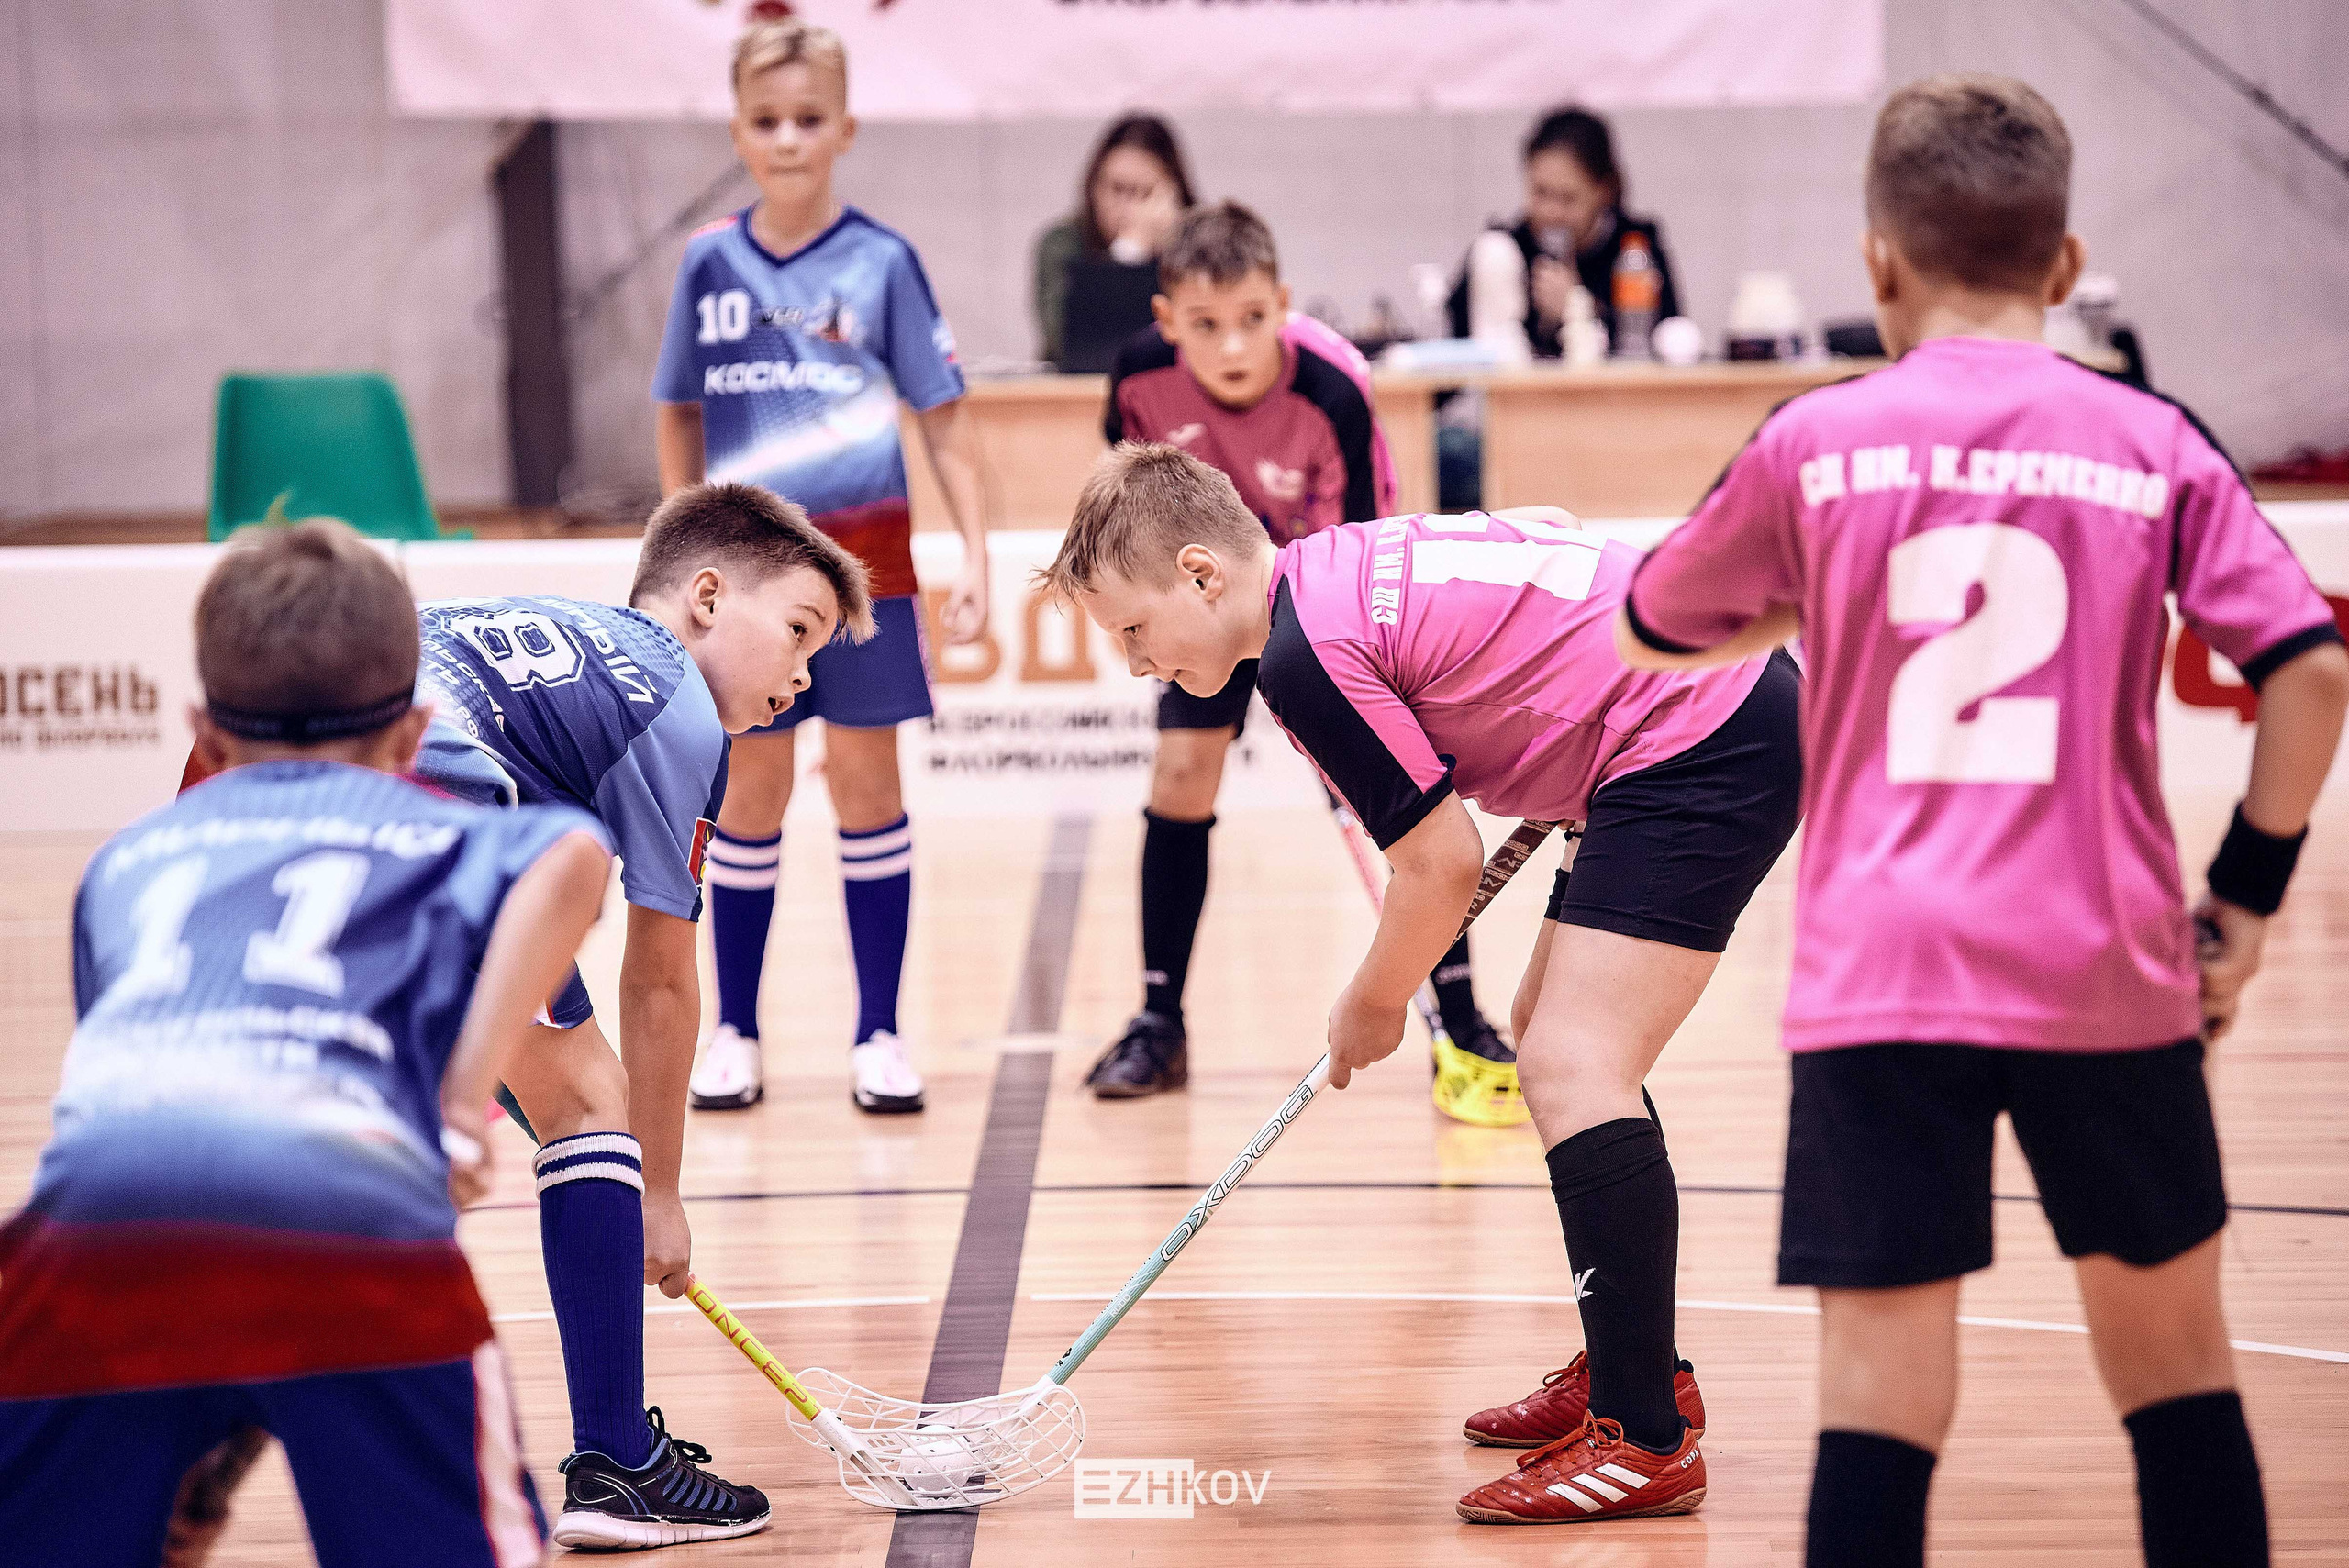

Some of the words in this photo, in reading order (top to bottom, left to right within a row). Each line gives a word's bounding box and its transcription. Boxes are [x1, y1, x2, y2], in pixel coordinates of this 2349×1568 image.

[696, 288, 751, 345] 10
[703, 361, 863, 395] КОСМОС
[1370, 587, 1402, 626] СШ
[422, 601, 587, 692] 8
[1887, 522, 2069, 784] 2
[0, 664, 160, 717] СЕНЬ
[128, 848, 372, 1000] 11
[1161, 1084, 1314, 1262] OXDOG
[692, 1289, 822, 1422] ONCEPT
[1680, 1449, 1700, 1469] COPA
